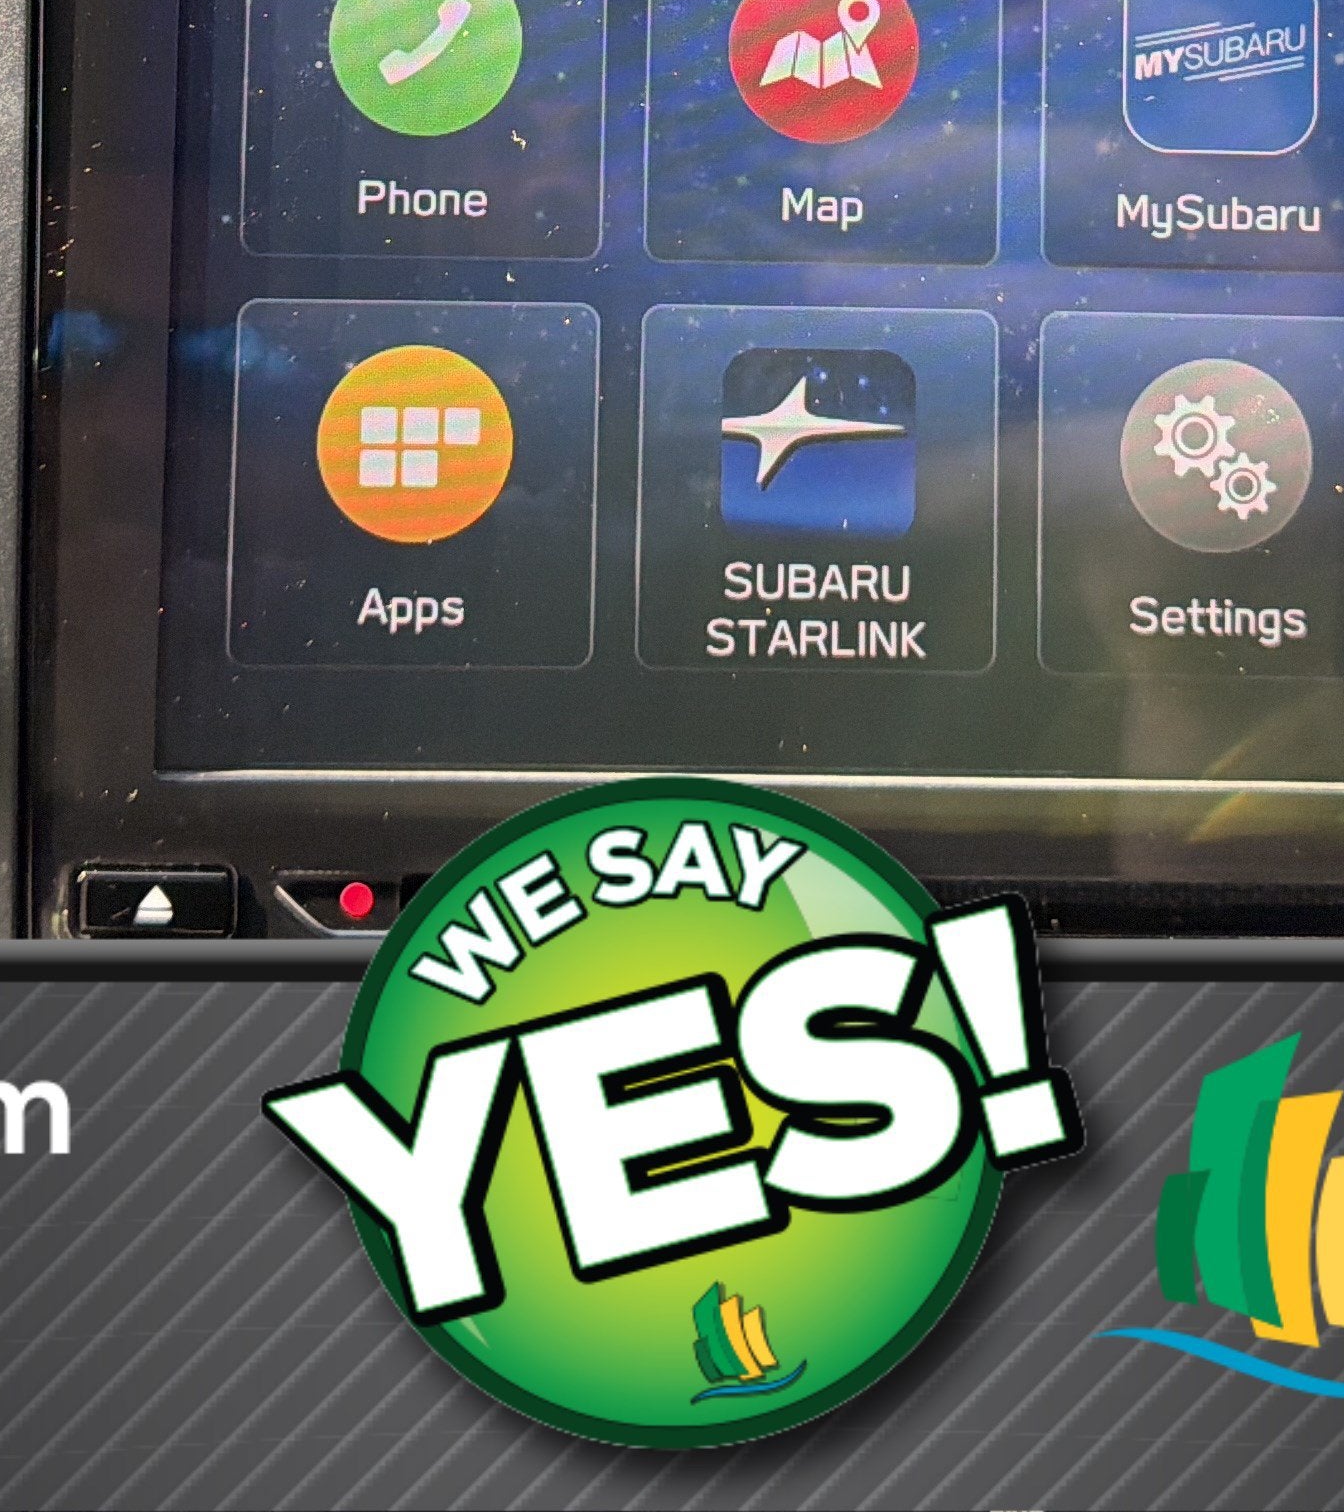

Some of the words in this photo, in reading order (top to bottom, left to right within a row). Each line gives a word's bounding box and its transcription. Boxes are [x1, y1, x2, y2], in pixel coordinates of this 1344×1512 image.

[1134, 23, 1307, 81] MYSUBARU
[356, 179, 489, 218] Phone
[781, 188, 864, 231] Map
[1116, 194, 1322, 237] MySubaru
[723, 562, 911, 603] SUBARU
[357, 587, 465, 635] Apps
[1128, 595, 1308, 646] Settings
[706, 618, 927, 658] STARLINK
